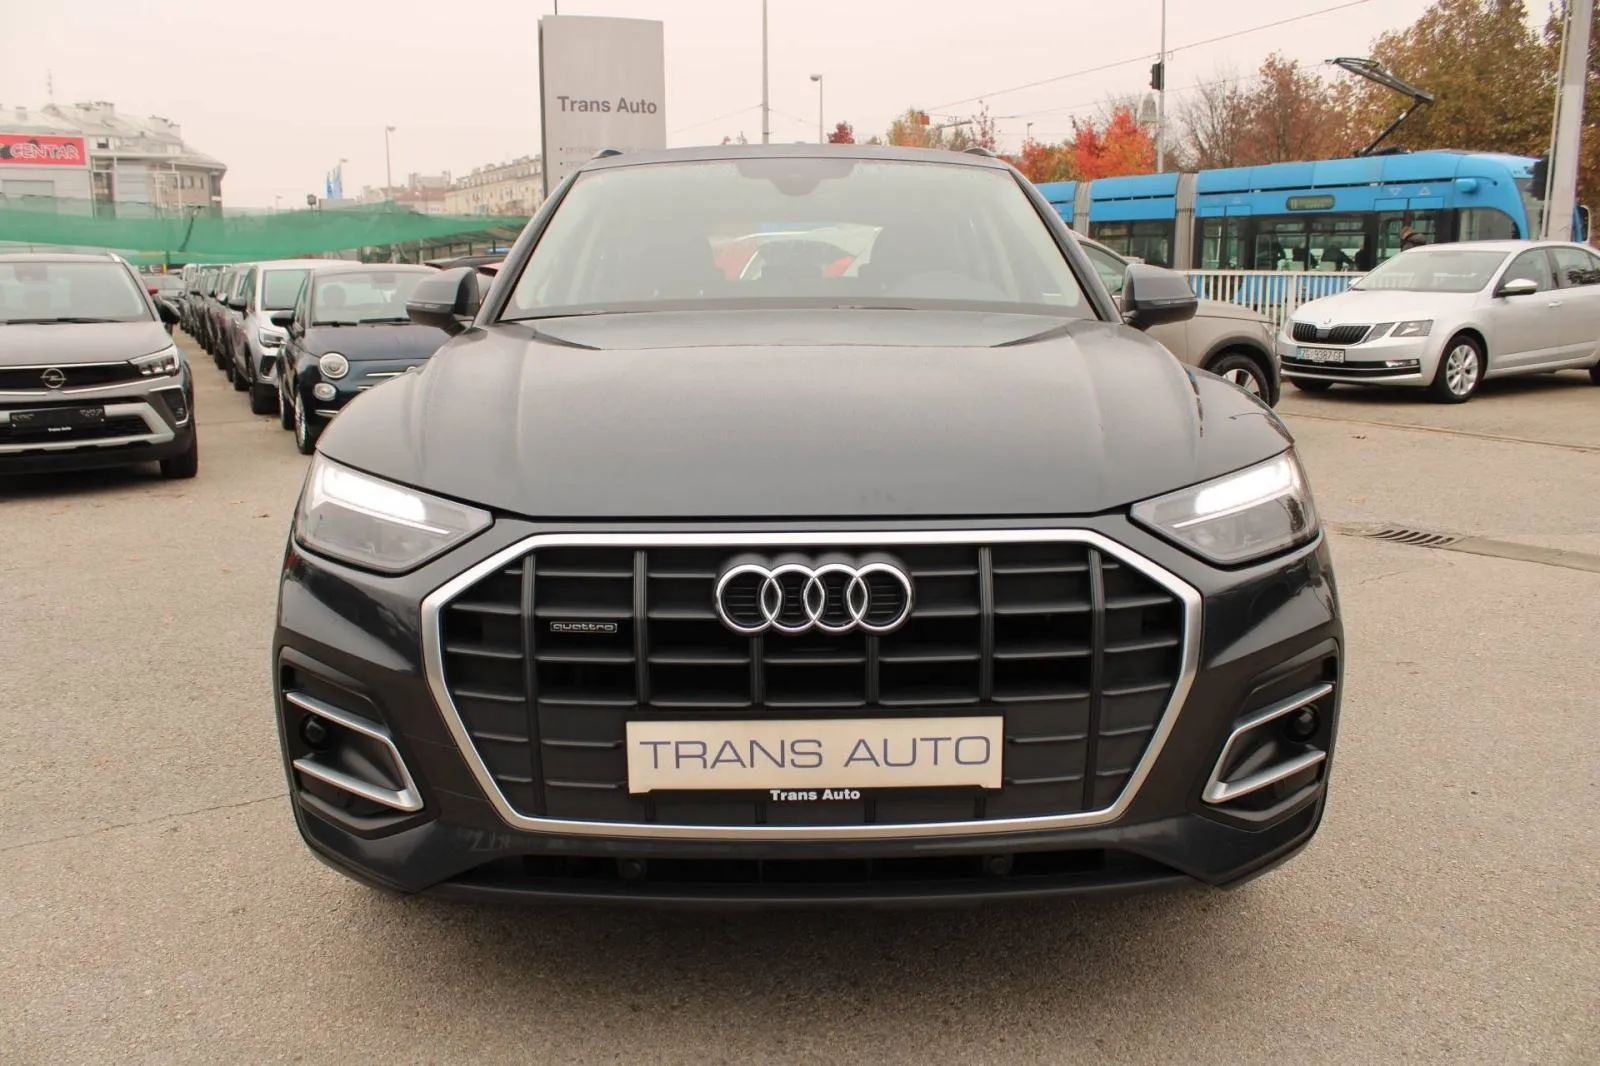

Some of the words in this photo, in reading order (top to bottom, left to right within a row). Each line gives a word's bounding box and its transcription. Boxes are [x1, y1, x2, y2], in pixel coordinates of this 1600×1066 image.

[557, 96, 611, 113] Trans
[617, 97, 657, 114] Auto
[10, 142, 80, 160] CENTAR
[553, 623, 614, 631] quattro
[639, 739, 823, 769] TRANS
[844, 735, 991, 768] AUTO
[769, 789, 818, 801] Trans
[822, 788, 861, 800] Auto
